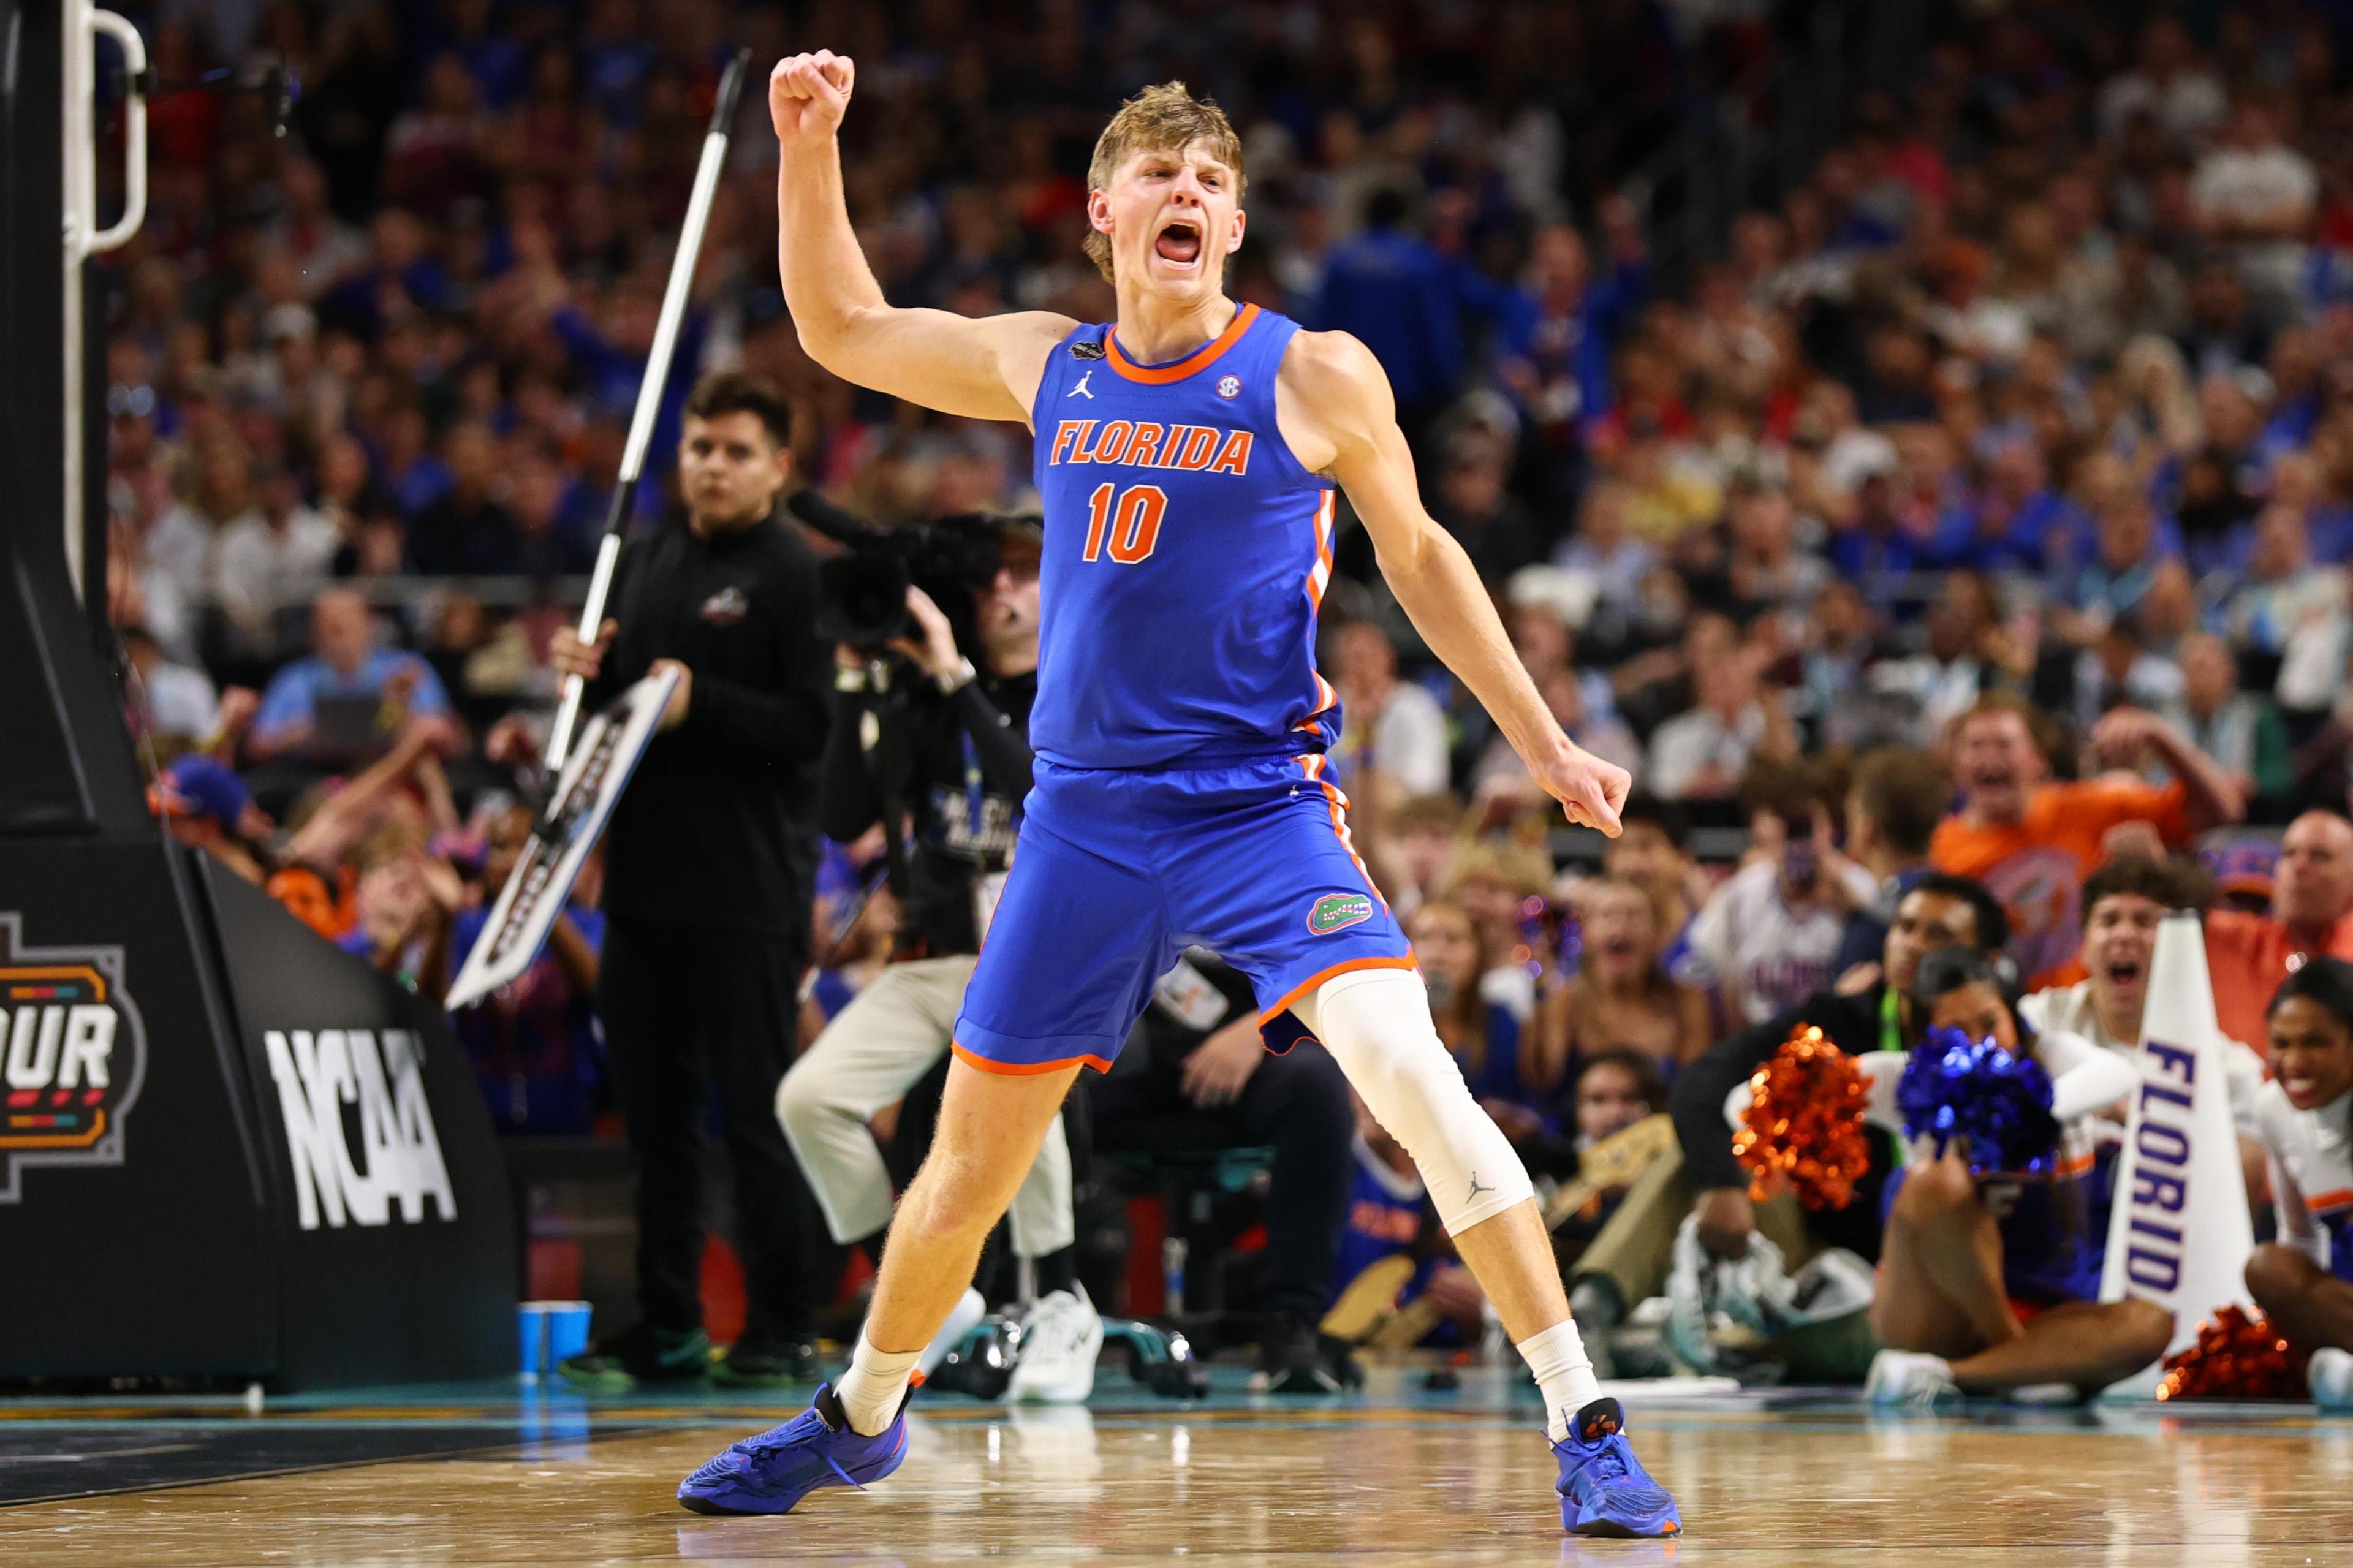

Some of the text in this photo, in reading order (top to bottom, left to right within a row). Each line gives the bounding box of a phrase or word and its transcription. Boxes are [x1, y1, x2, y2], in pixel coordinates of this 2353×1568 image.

[1049, 419, 1254, 477] FLORIDA
[1082, 482, 1169, 564] 10
[0, 1004, 118, 1089] UR
[264, 1028, 458, 1230] NCAA
[2126, 1040, 2196, 1317] FLORID
